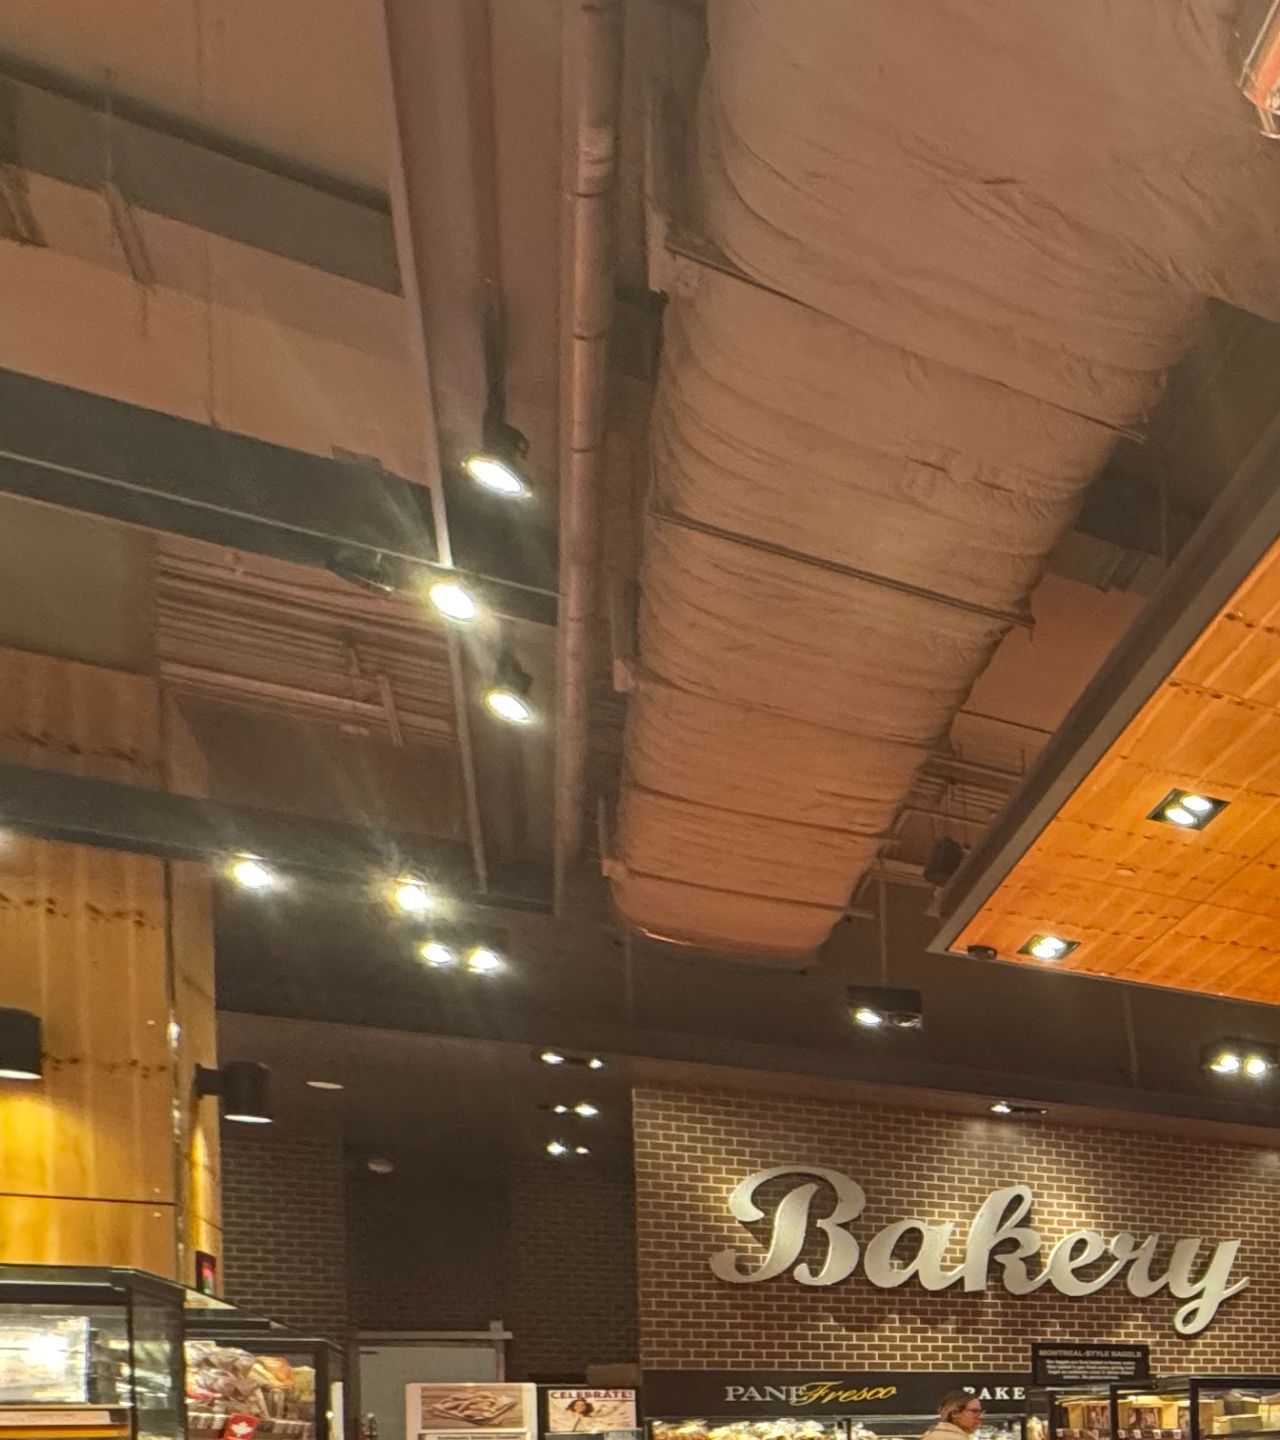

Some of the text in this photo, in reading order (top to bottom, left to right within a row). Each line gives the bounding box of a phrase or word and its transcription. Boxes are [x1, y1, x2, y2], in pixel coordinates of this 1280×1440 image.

[709, 1164, 1250, 1335] Bakery
[550, 1391, 633, 1400] CELEBRATE!
[725, 1381, 897, 1405] PANE Fresco
